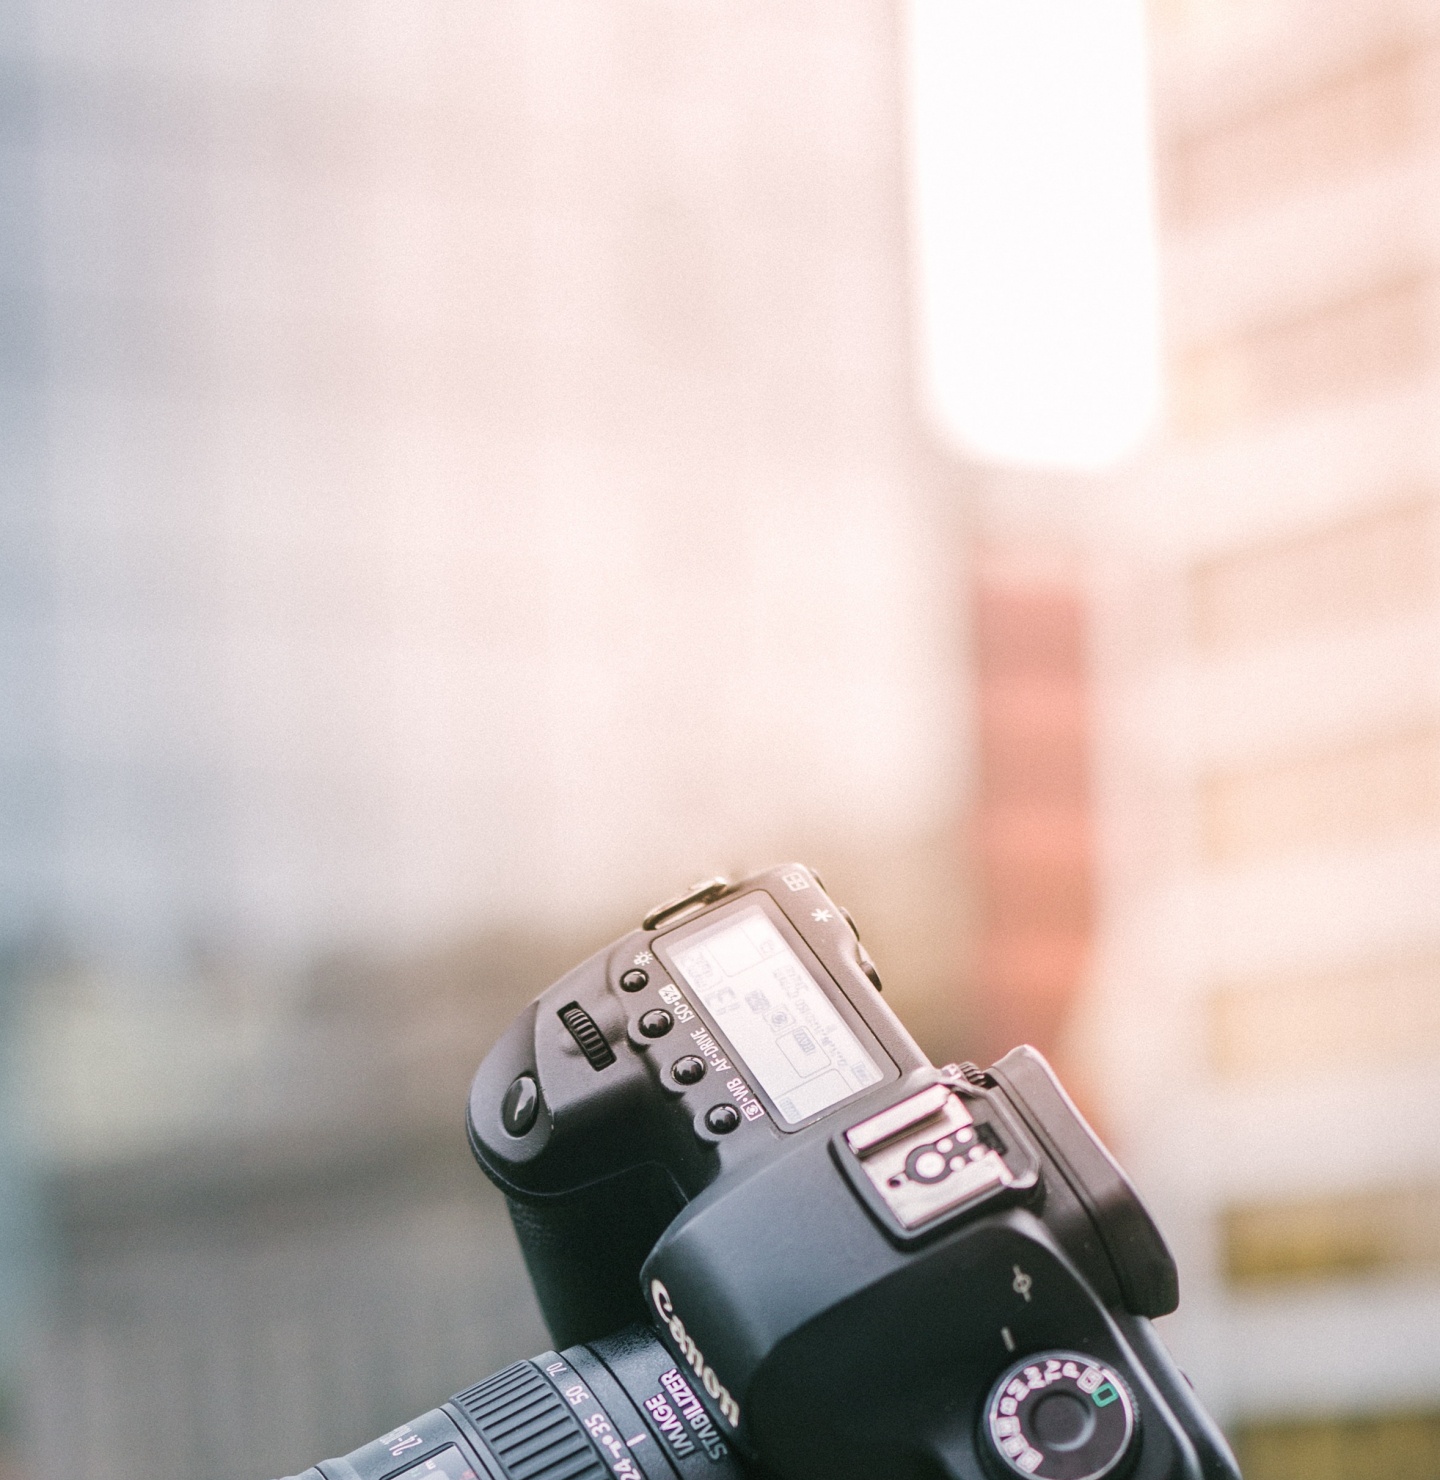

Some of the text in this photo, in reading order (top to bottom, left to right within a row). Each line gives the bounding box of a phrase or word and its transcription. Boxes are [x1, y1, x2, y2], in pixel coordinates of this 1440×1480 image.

[674, 1002, 695, 1023] ISO
[652, 1279, 740, 1428] Canon
[546, 1362, 567, 1377] 70
[566, 1385, 589, 1405] 50
[584, 1413, 611, 1438] 35
[645, 1393, 695, 1457] IMAGE
[660, 1368, 728, 1460] STABILIZER
